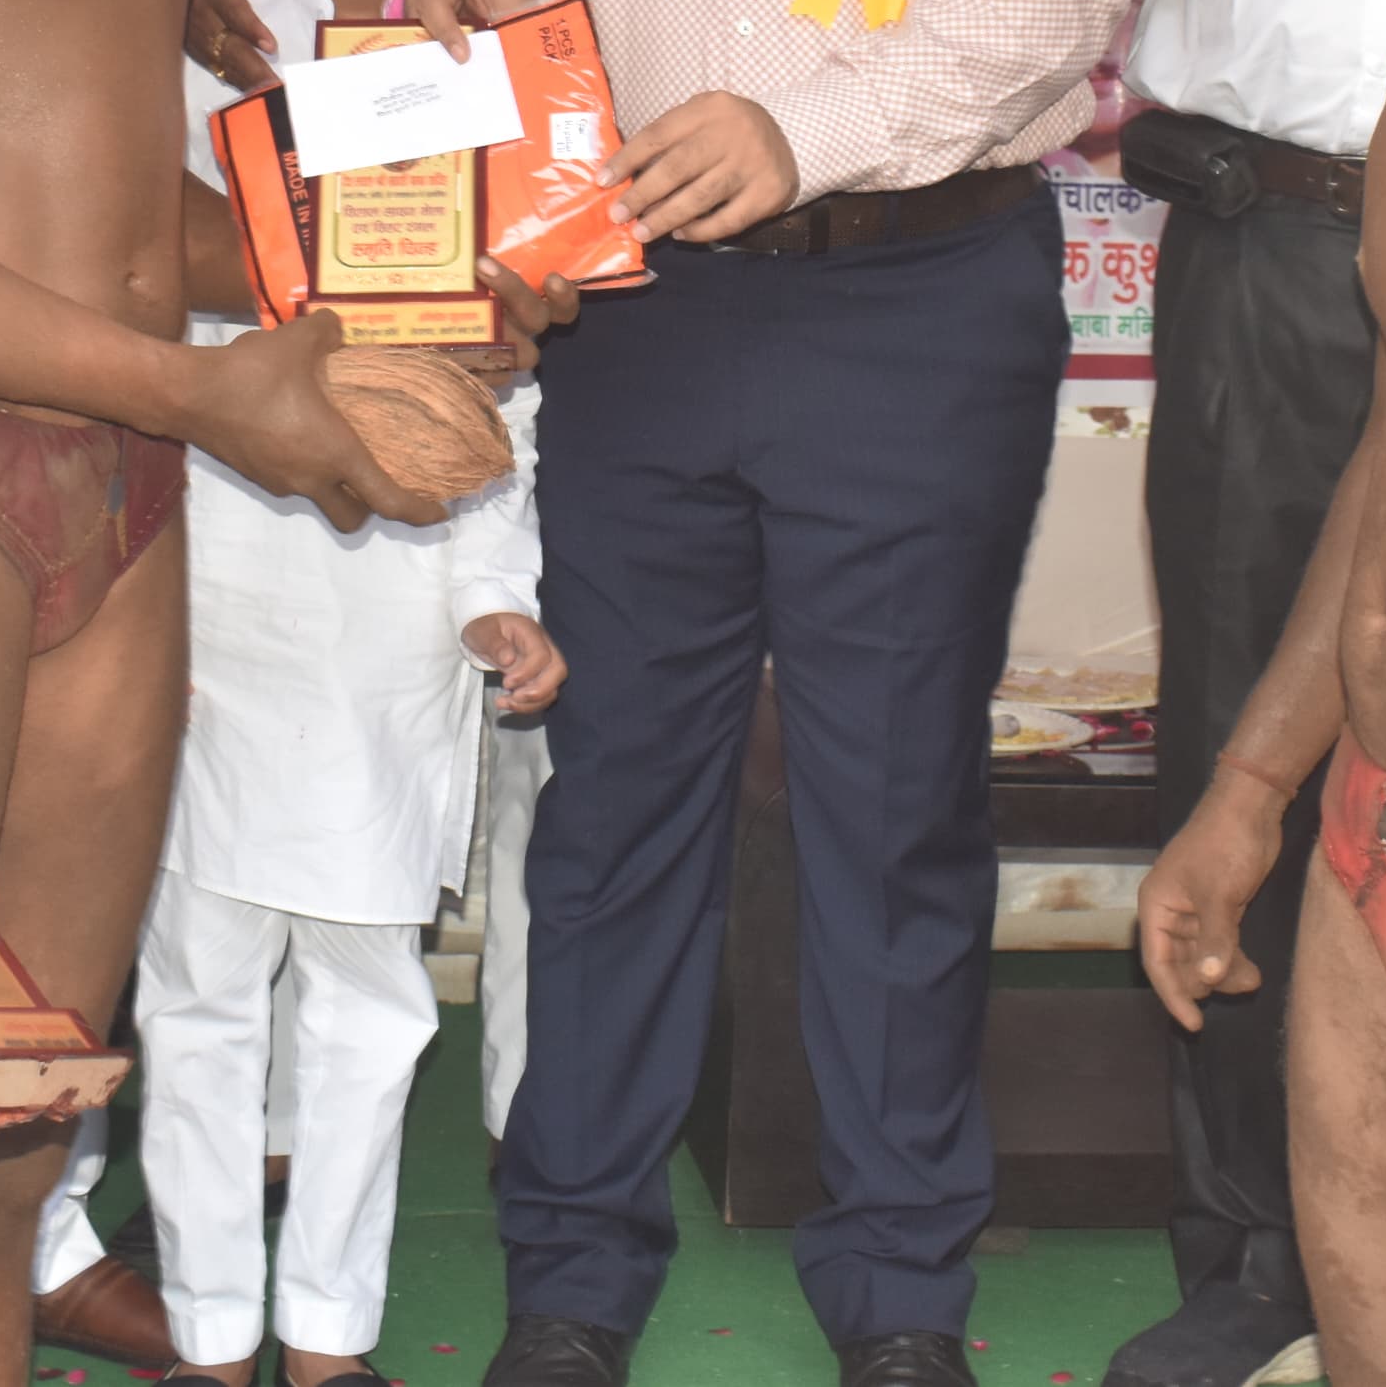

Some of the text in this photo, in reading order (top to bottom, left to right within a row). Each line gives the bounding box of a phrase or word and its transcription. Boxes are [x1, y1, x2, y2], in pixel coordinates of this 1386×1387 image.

[539, 26, 559, 61] PACK
[282, 149, 309, 202] MADE
[296, 205, 310, 225] IN
